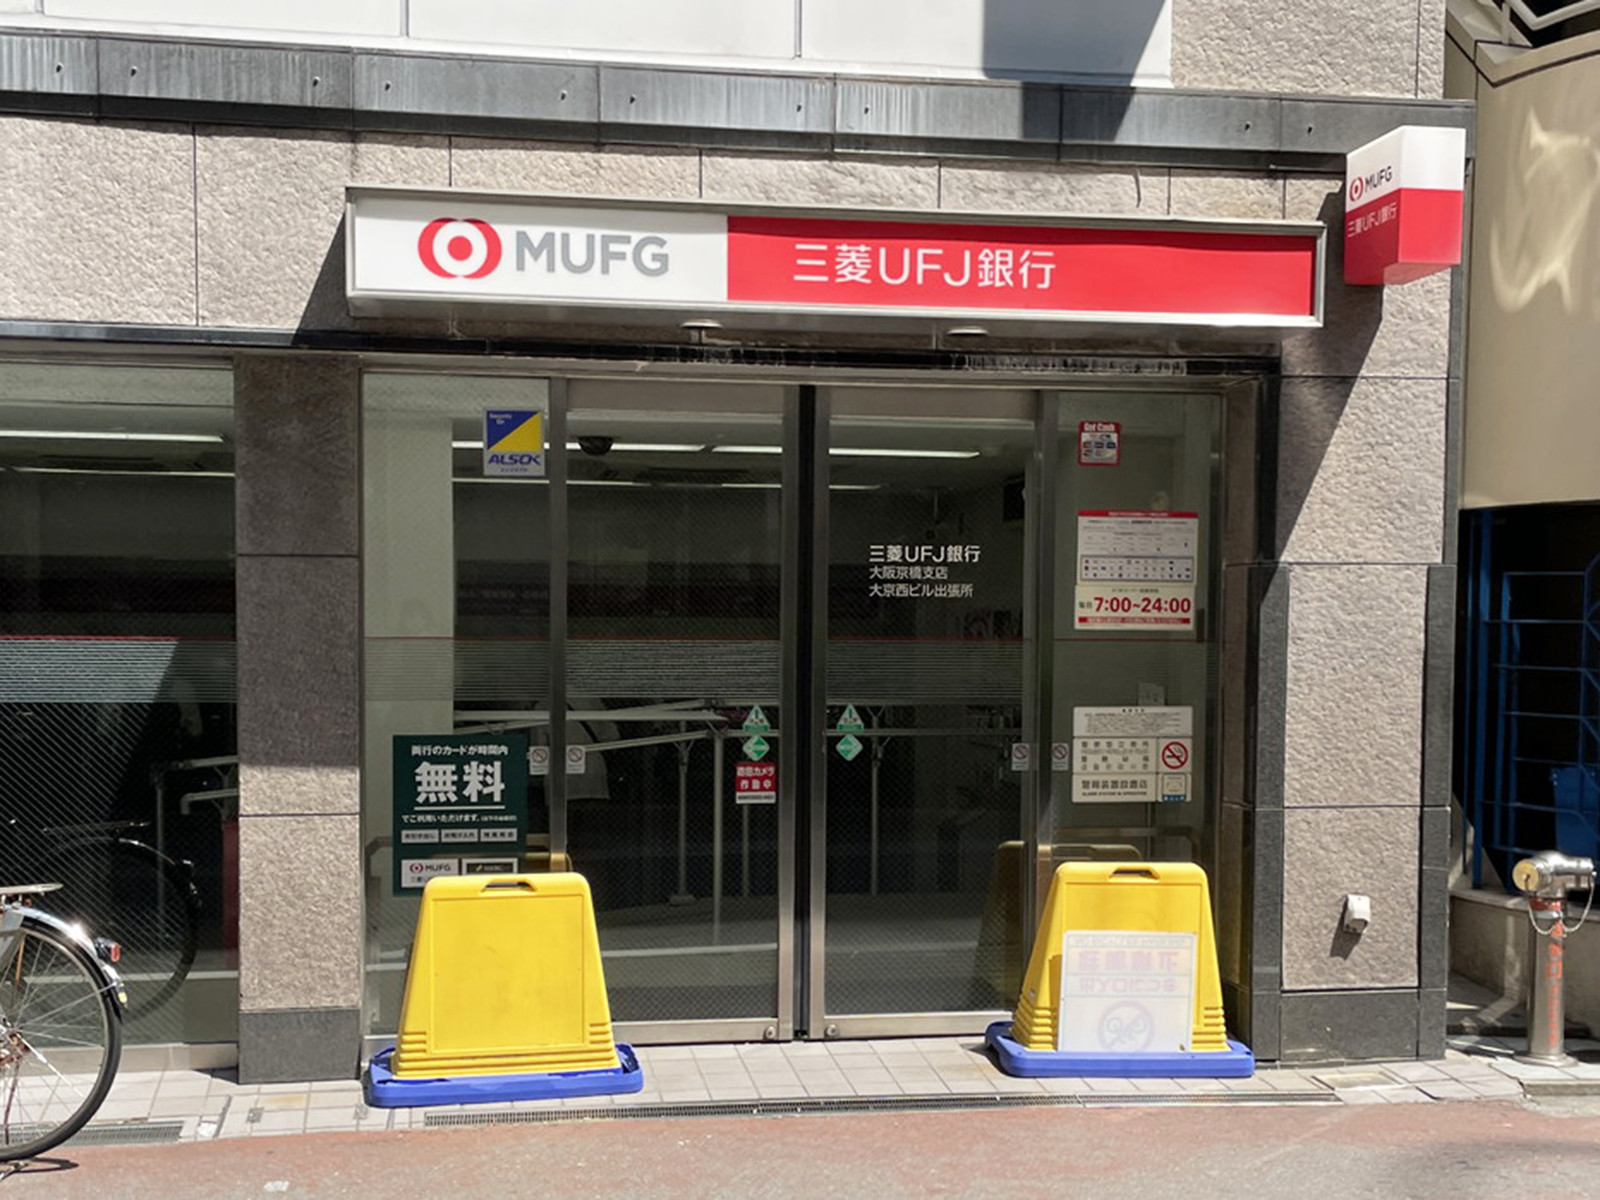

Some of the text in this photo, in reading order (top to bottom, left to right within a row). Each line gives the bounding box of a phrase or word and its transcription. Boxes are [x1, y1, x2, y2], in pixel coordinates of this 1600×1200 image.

[1364, 165, 1393, 192] MUFG
[515, 230, 670, 278] MUFG
[793, 243, 1056, 289] 三菱UFJ銀行
[487, 453, 541, 466] ALSOK
[869, 544, 981, 562] 三菱UFJ銀行
[868, 565, 949, 580] 大阪京橋支店
[868, 583, 974, 598] 大京西ビル出張所
[414, 761, 506, 803] 無料
[425, 863, 451, 872] MUFG
